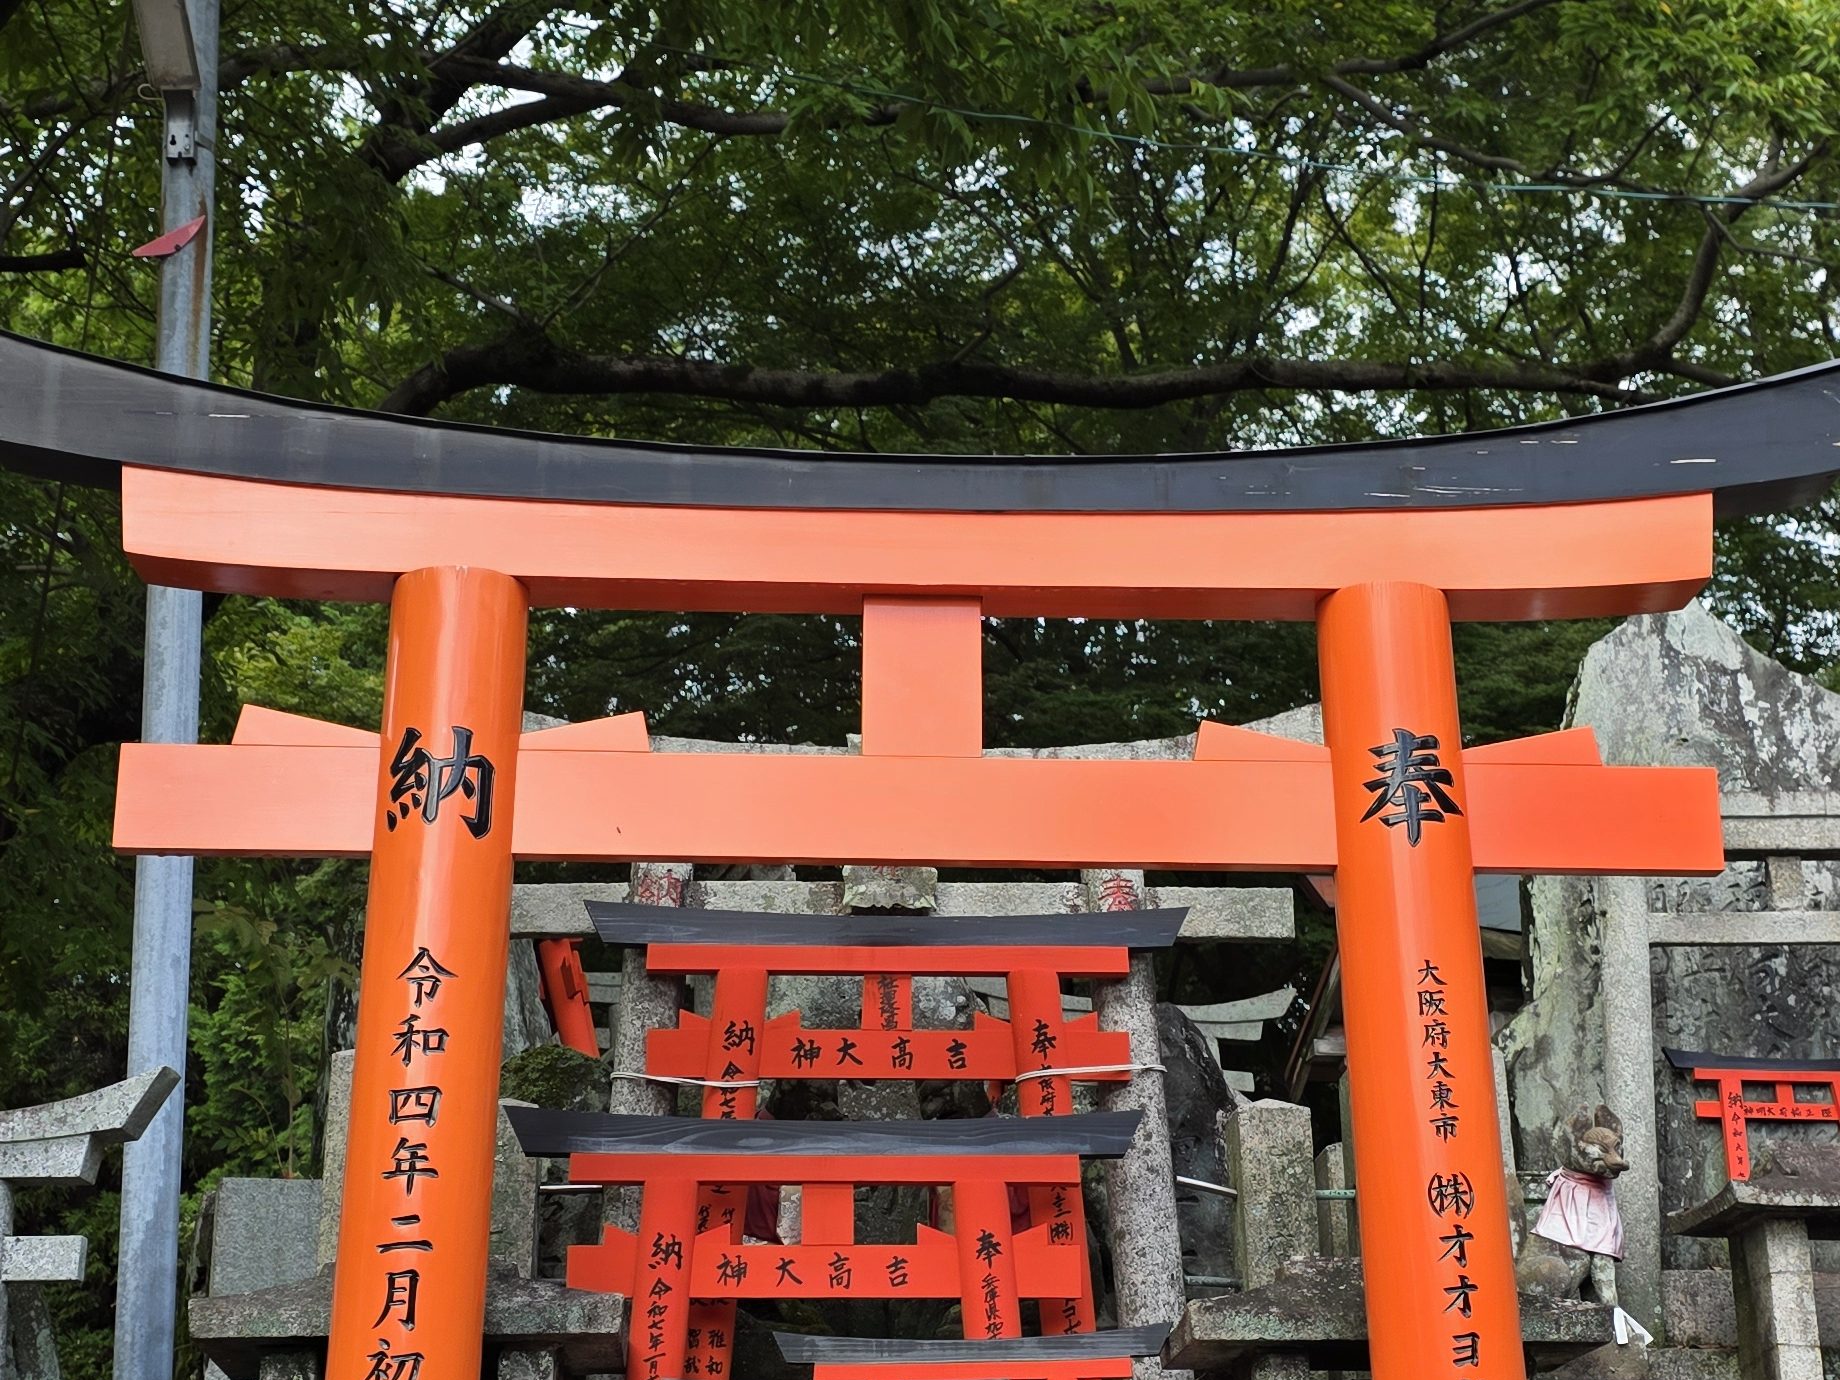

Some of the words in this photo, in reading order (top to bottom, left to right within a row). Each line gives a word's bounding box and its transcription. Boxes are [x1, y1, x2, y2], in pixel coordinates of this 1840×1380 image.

[386, 726, 496, 840] 納
[1360, 728, 1464, 847] 奉
[1417, 959, 1460, 1144] 大阪府大東市
[722, 1020, 756, 1056] 納
[1031, 1019, 1056, 1061] 奉
[1728, 1091, 1743, 1110] 納
[648, 1232, 683, 1270] 納
[976, 1229, 1003, 1270] 奉
[982, 1272, 1003, 1339] 兵庫県加
